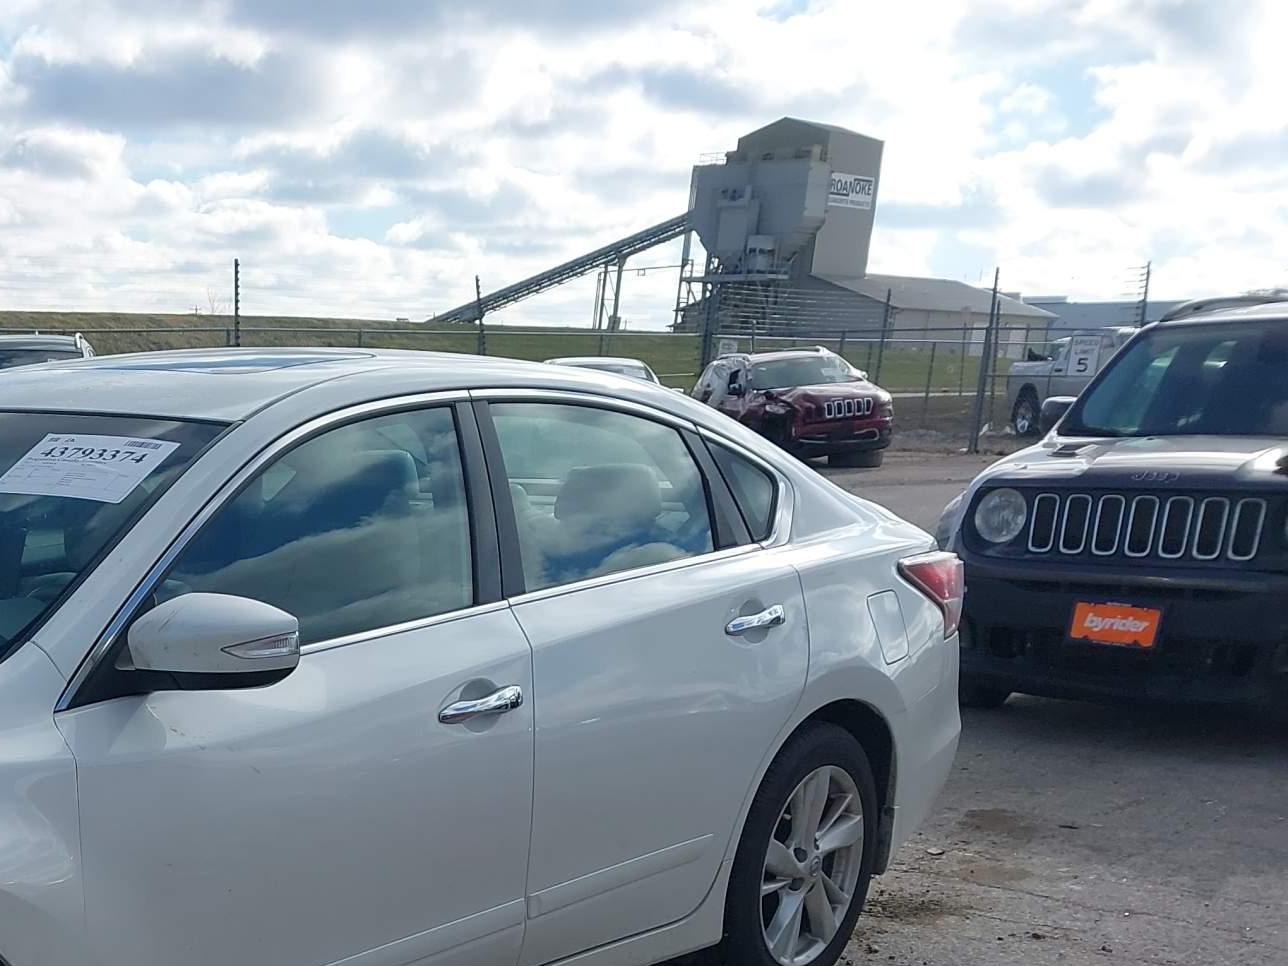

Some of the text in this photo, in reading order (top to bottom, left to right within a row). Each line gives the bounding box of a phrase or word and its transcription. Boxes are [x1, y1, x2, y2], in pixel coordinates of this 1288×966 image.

[830, 178, 873, 196] ROANOKE
[1076, 357, 1089, 373] 5
[40, 446, 149, 464] 43793374
[1131, 470, 1181, 484] Jeep
[1083, 613, 1150, 633] byrider
